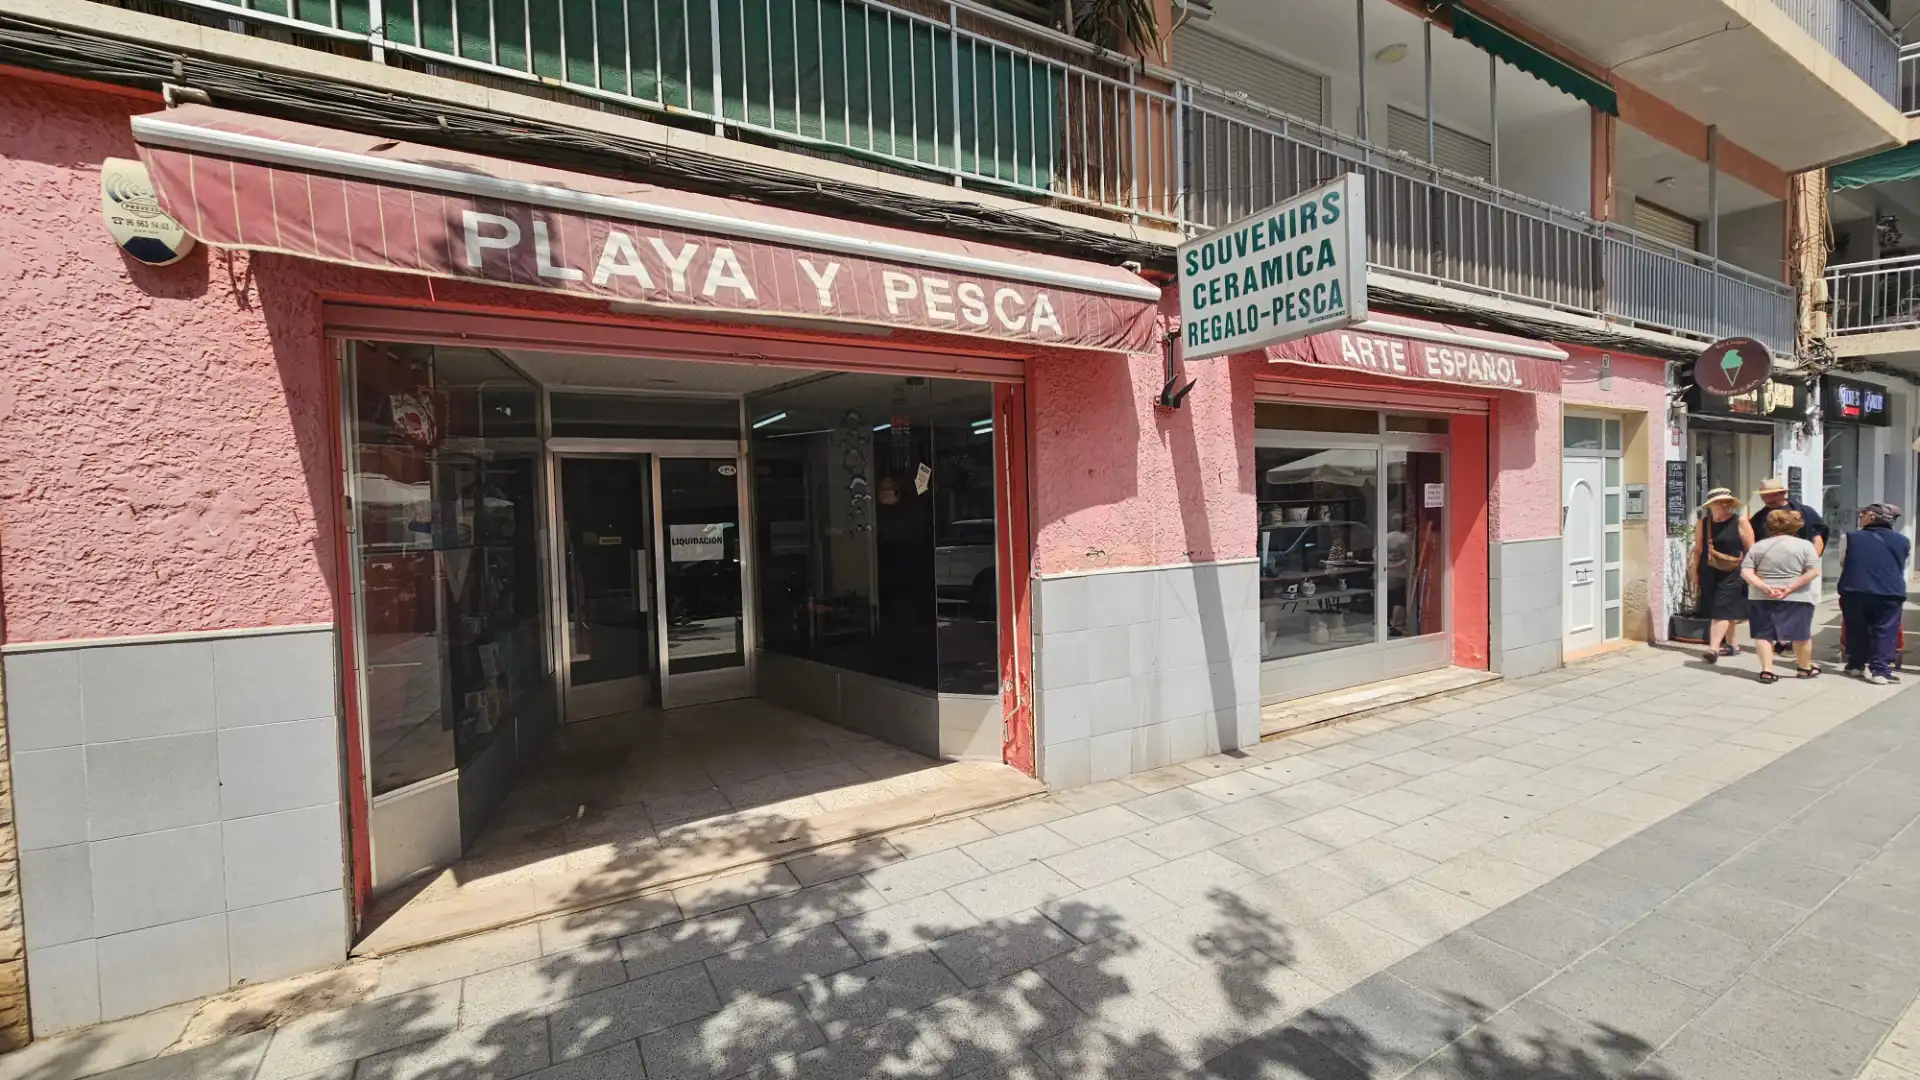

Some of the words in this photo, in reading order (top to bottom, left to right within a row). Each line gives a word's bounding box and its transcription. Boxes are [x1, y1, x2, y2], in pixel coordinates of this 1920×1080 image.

[1185, 191, 1341, 277] SOUVENIRS
[462, 209, 757, 300] PLAYA
[798, 258, 841, 307] Y
[882, 270, 1063, 336] PESCA
[1192, 237, 1337, 310] CERAMICA
[1188, 278, 1344, 348] REGALO-PESCA
[1340, 334, 1408, 372] ARTE
[1425, 346, 1522, 385] ESPAÑOL
